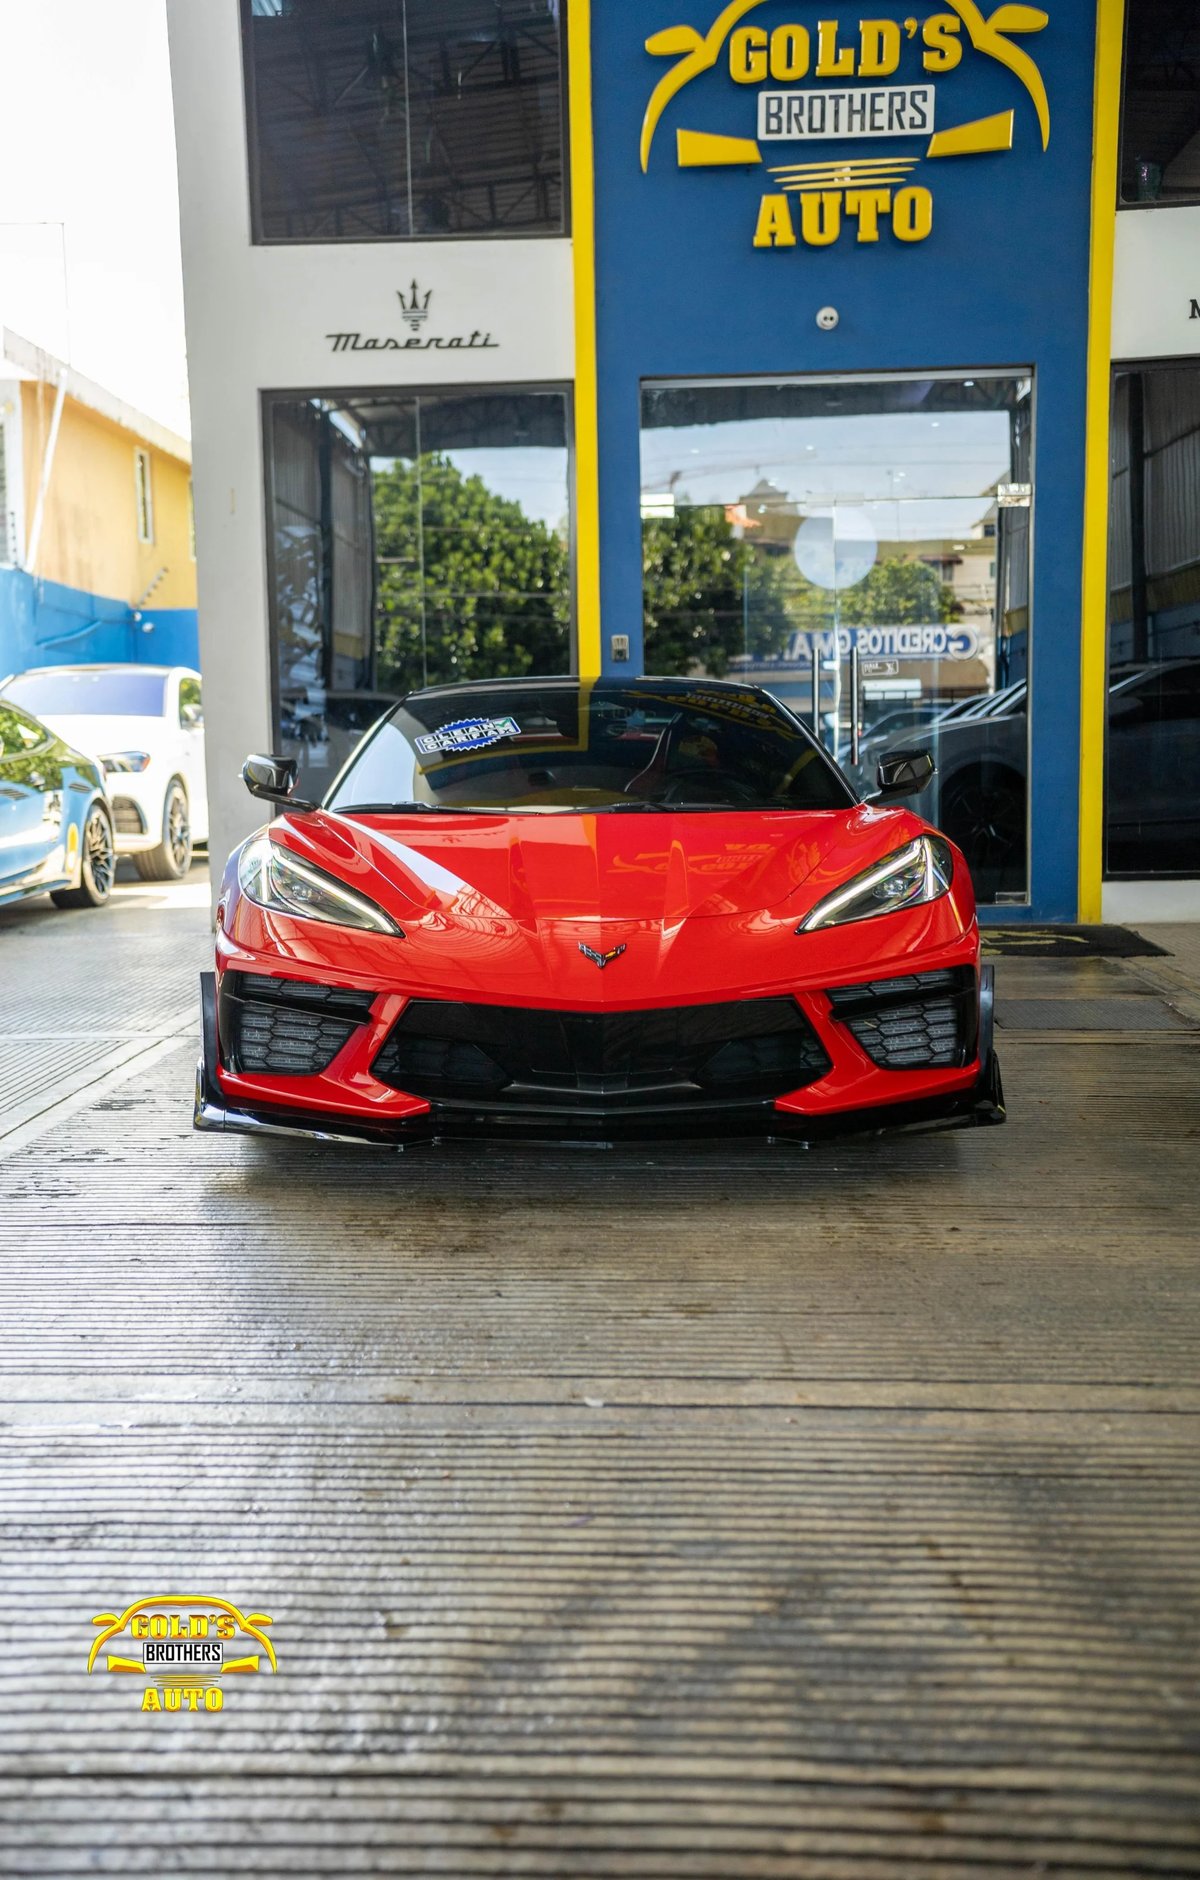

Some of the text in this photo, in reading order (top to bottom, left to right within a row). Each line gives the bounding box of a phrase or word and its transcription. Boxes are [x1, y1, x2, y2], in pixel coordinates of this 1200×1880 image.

[729, 13, 962, 84] GOLD'S
[764, 89, 928, 135] BROTHERS
[753, 186, 933, 247] AUTO
[325, 331, 500, 352] Maserati
[422, 722, 495, 744] CLEAN
[426, 728, 512, 751] CARFAX
